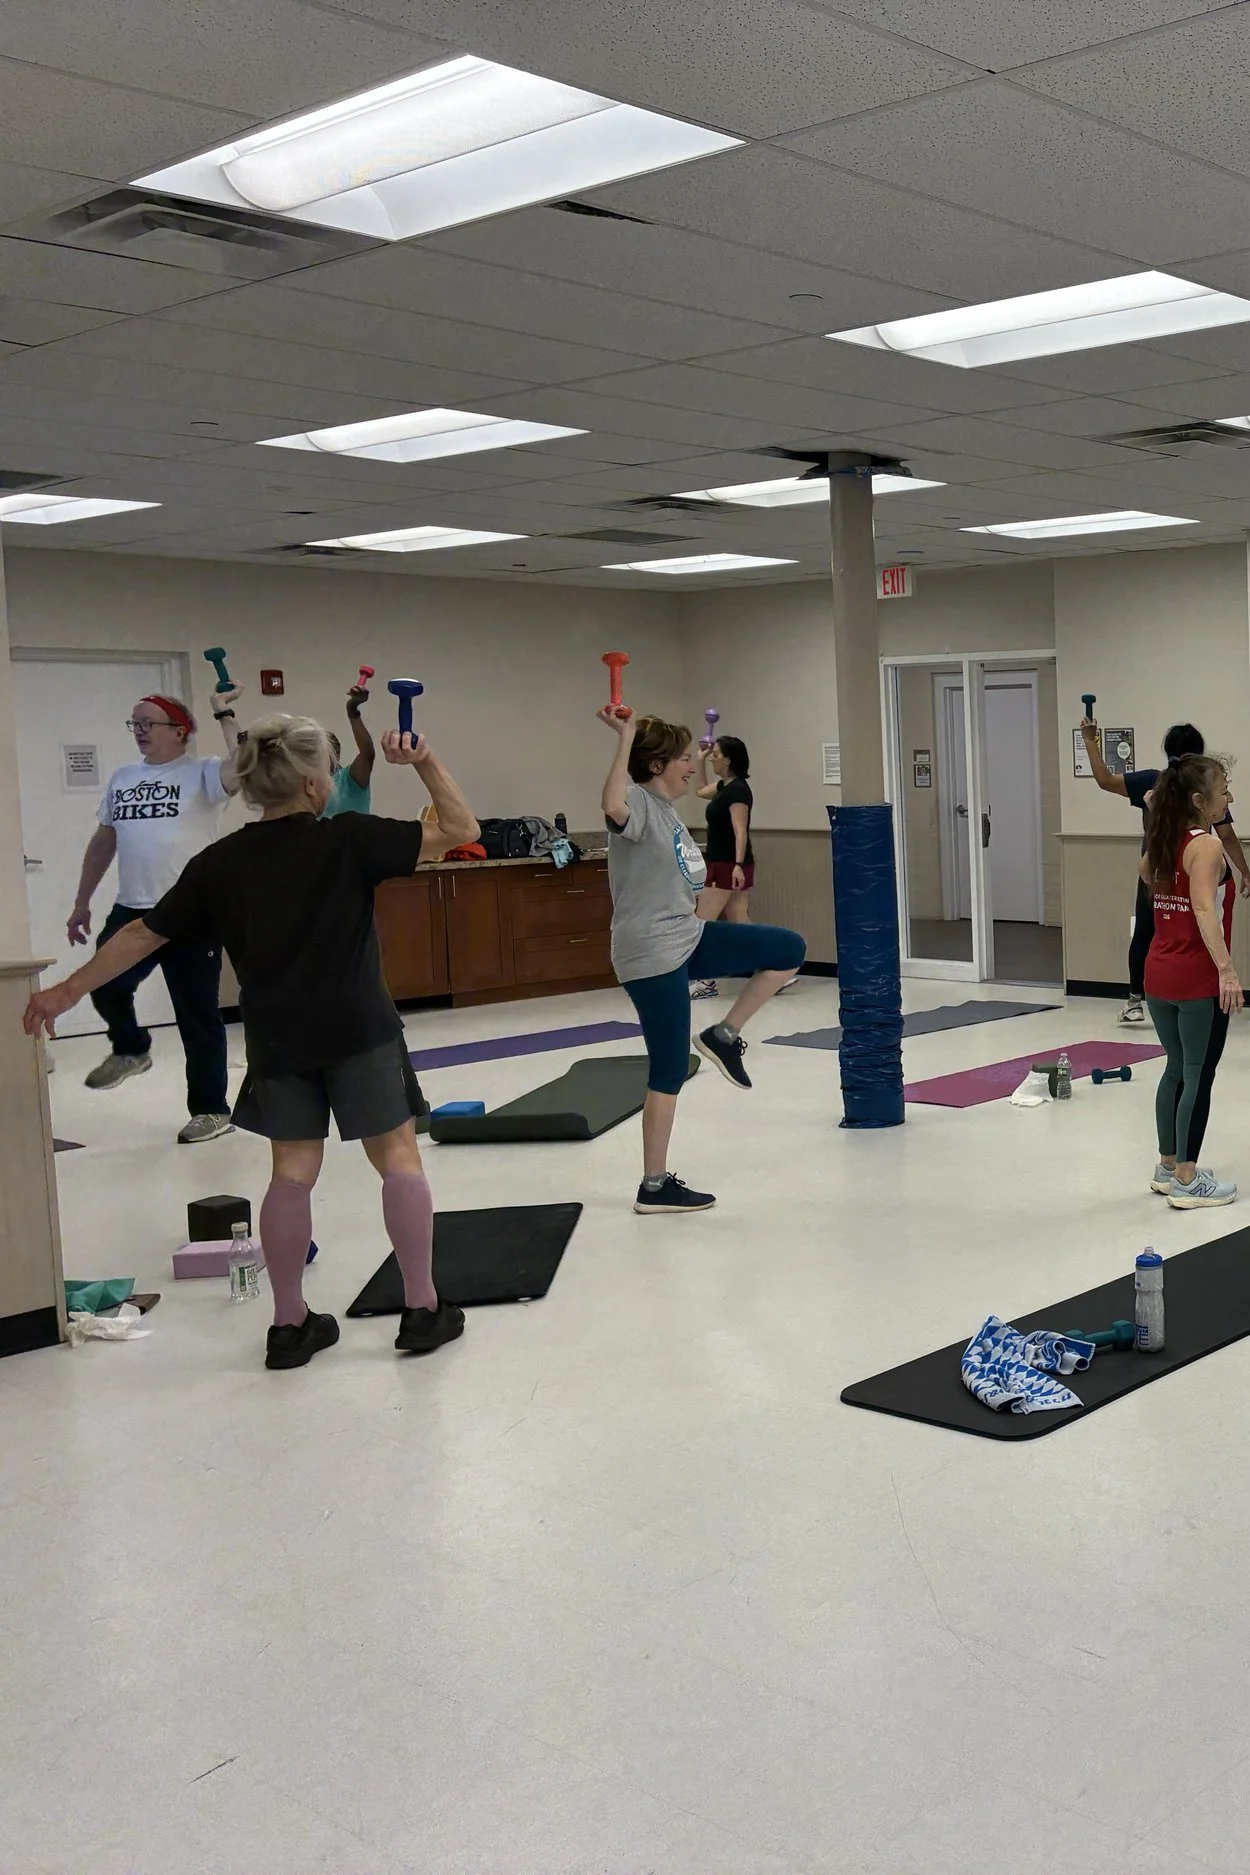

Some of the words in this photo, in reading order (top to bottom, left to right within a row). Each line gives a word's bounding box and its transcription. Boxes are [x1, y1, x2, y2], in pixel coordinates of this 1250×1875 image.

[882, 568, 905, 595] EXIT
[113, 782, 180, 804] BOSTON
[113, 803, 179, 821] BIKES
